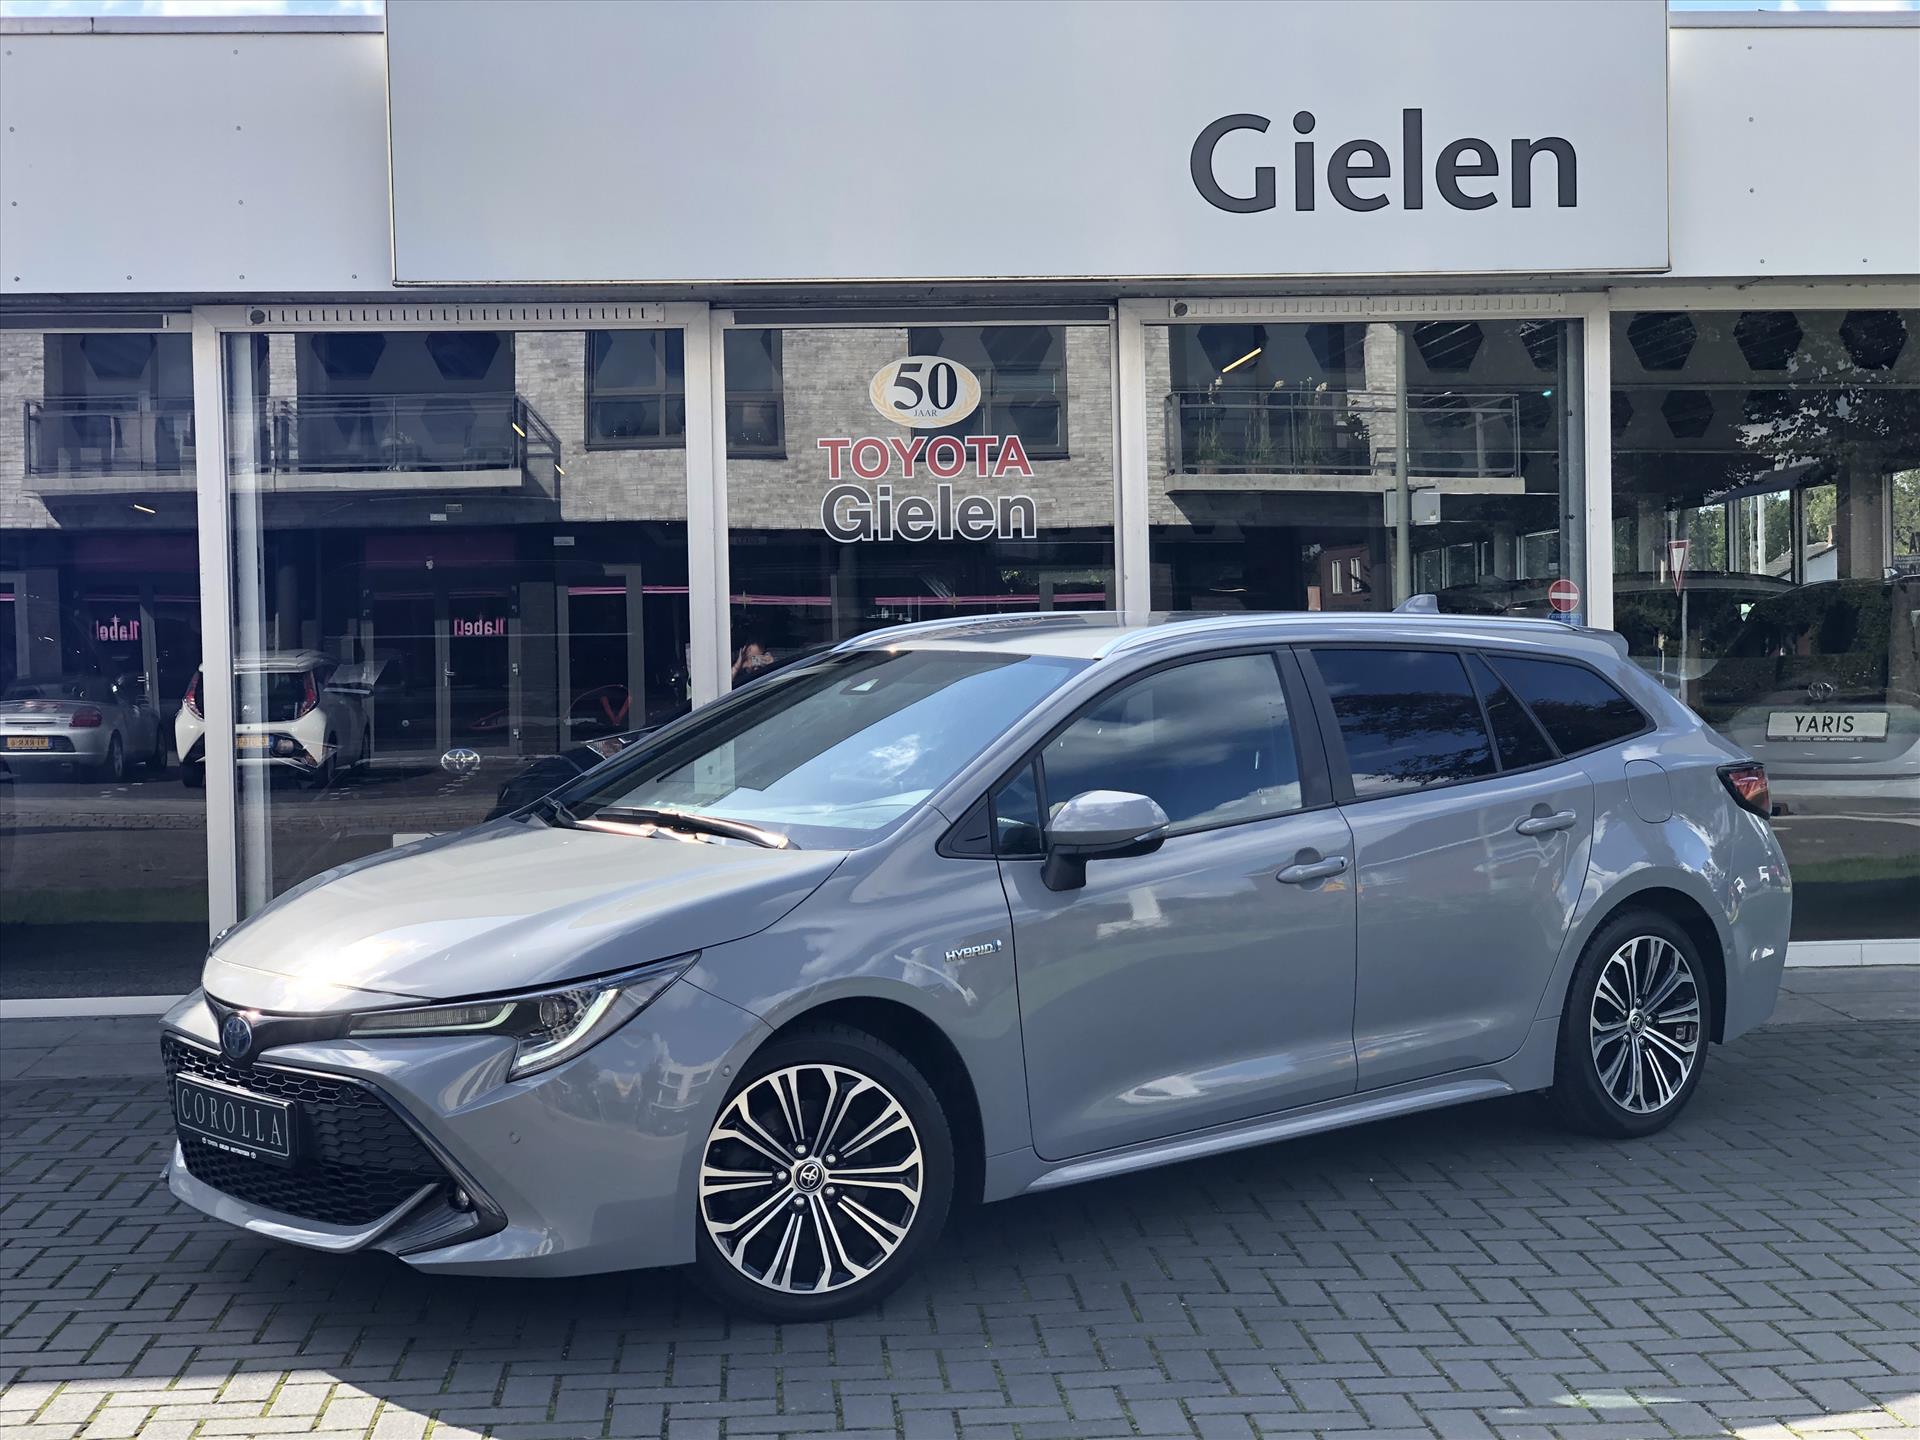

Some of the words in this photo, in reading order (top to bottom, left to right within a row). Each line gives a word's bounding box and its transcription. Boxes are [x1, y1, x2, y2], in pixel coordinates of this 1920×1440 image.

[1190, 108, 1577, 213] Gielen
[893, 362, 957, 410] 50
[913, 409, 938, 417] JAAR
[817, 435, 1034, 479] TOYOTA
[821, 484, 1037, 543] Gielen
[1794, 715, 1855, 733] YARIS
[945, 943, 993, 960] HYBRID
[181, 1088, 282, 1146] COROLLA
